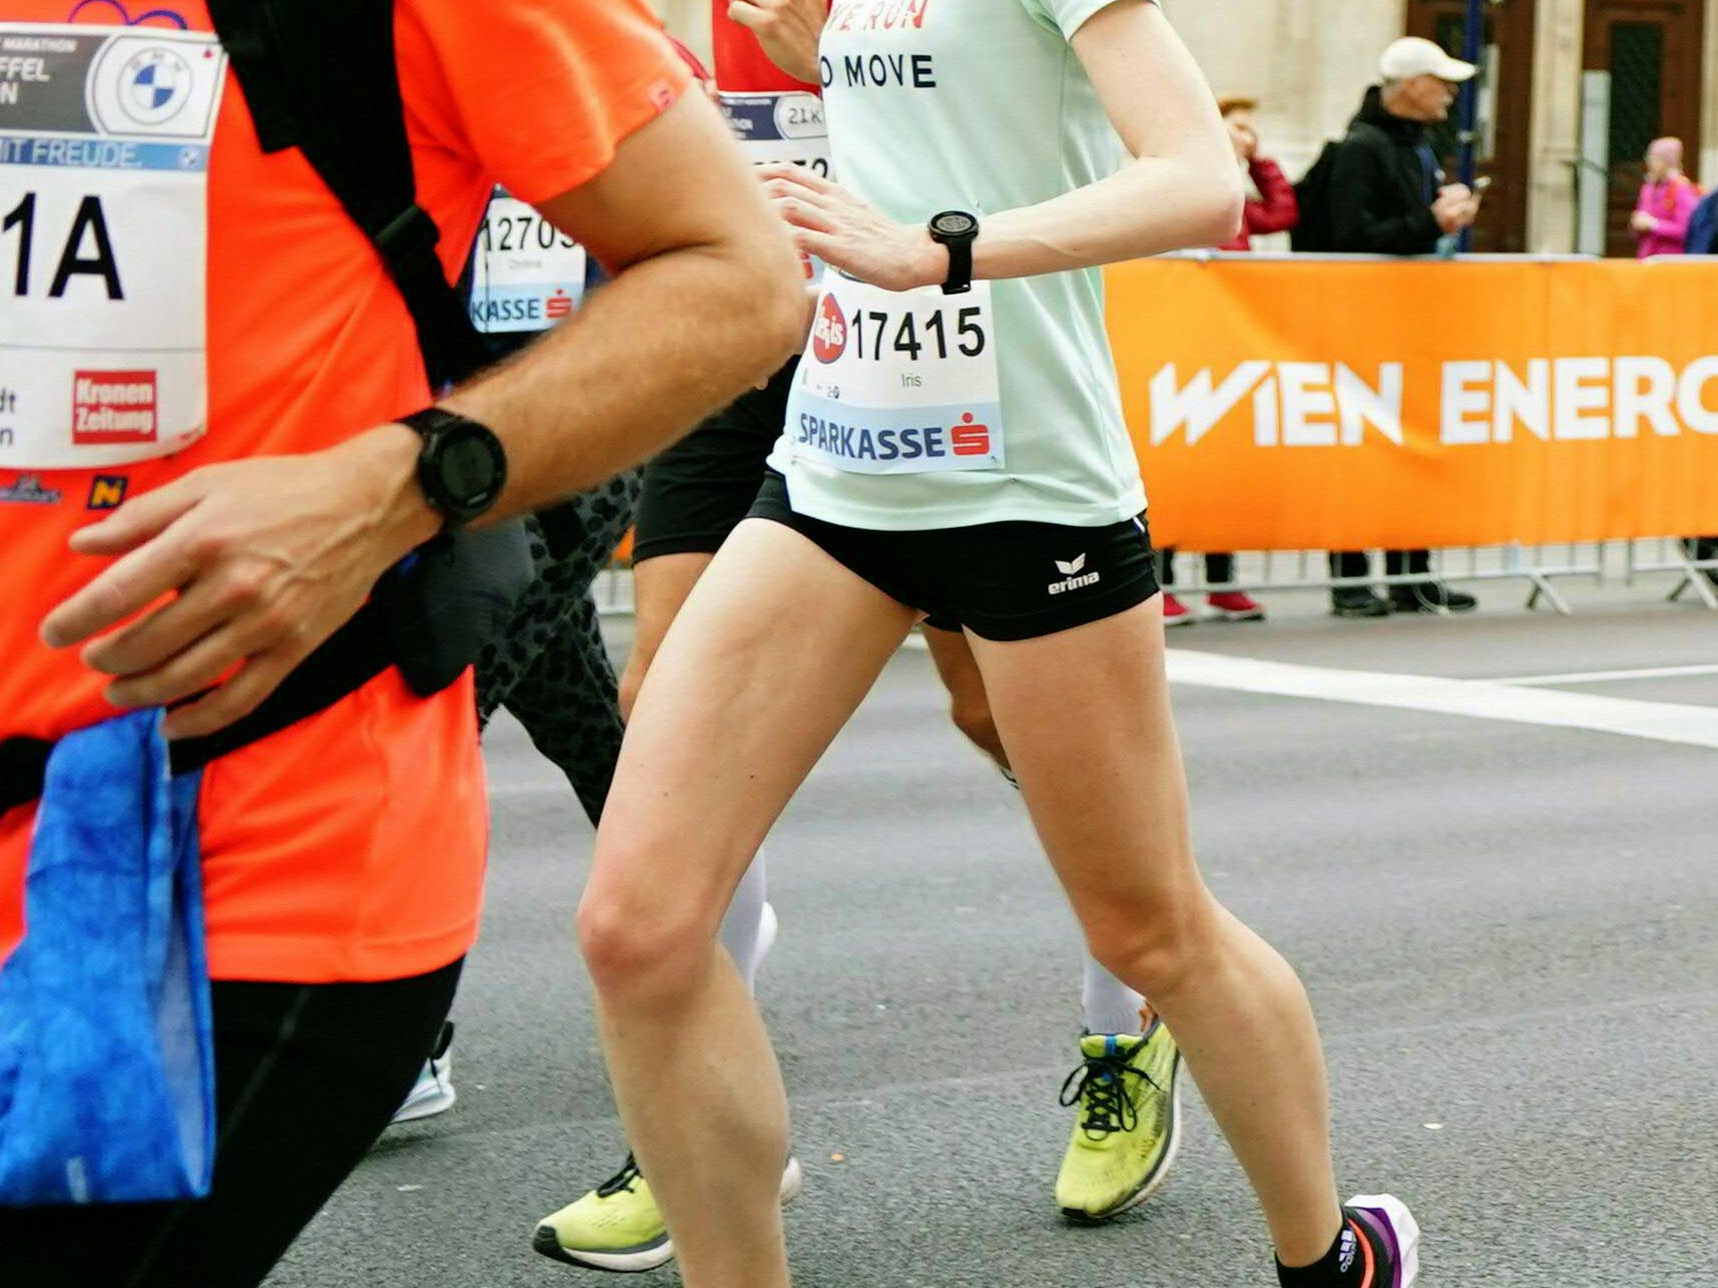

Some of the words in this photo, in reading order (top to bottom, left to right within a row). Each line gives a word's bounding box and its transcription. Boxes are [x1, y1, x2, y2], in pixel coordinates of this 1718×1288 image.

[844, 53, 937, 88] MOVE
[477, 216, 578, 251] 1270
[852, 306, 986, 361] 17415
[76, 378, 153, 405] Kronen
[901, 373, 922, 387] Iris
[76, 407, 154, 435] Zeitung
[1149, 360, 1402, 448] WIEN
[798, 413, 945, 461] SPARKASSE
[1047, 571, 1100, 595] erima
